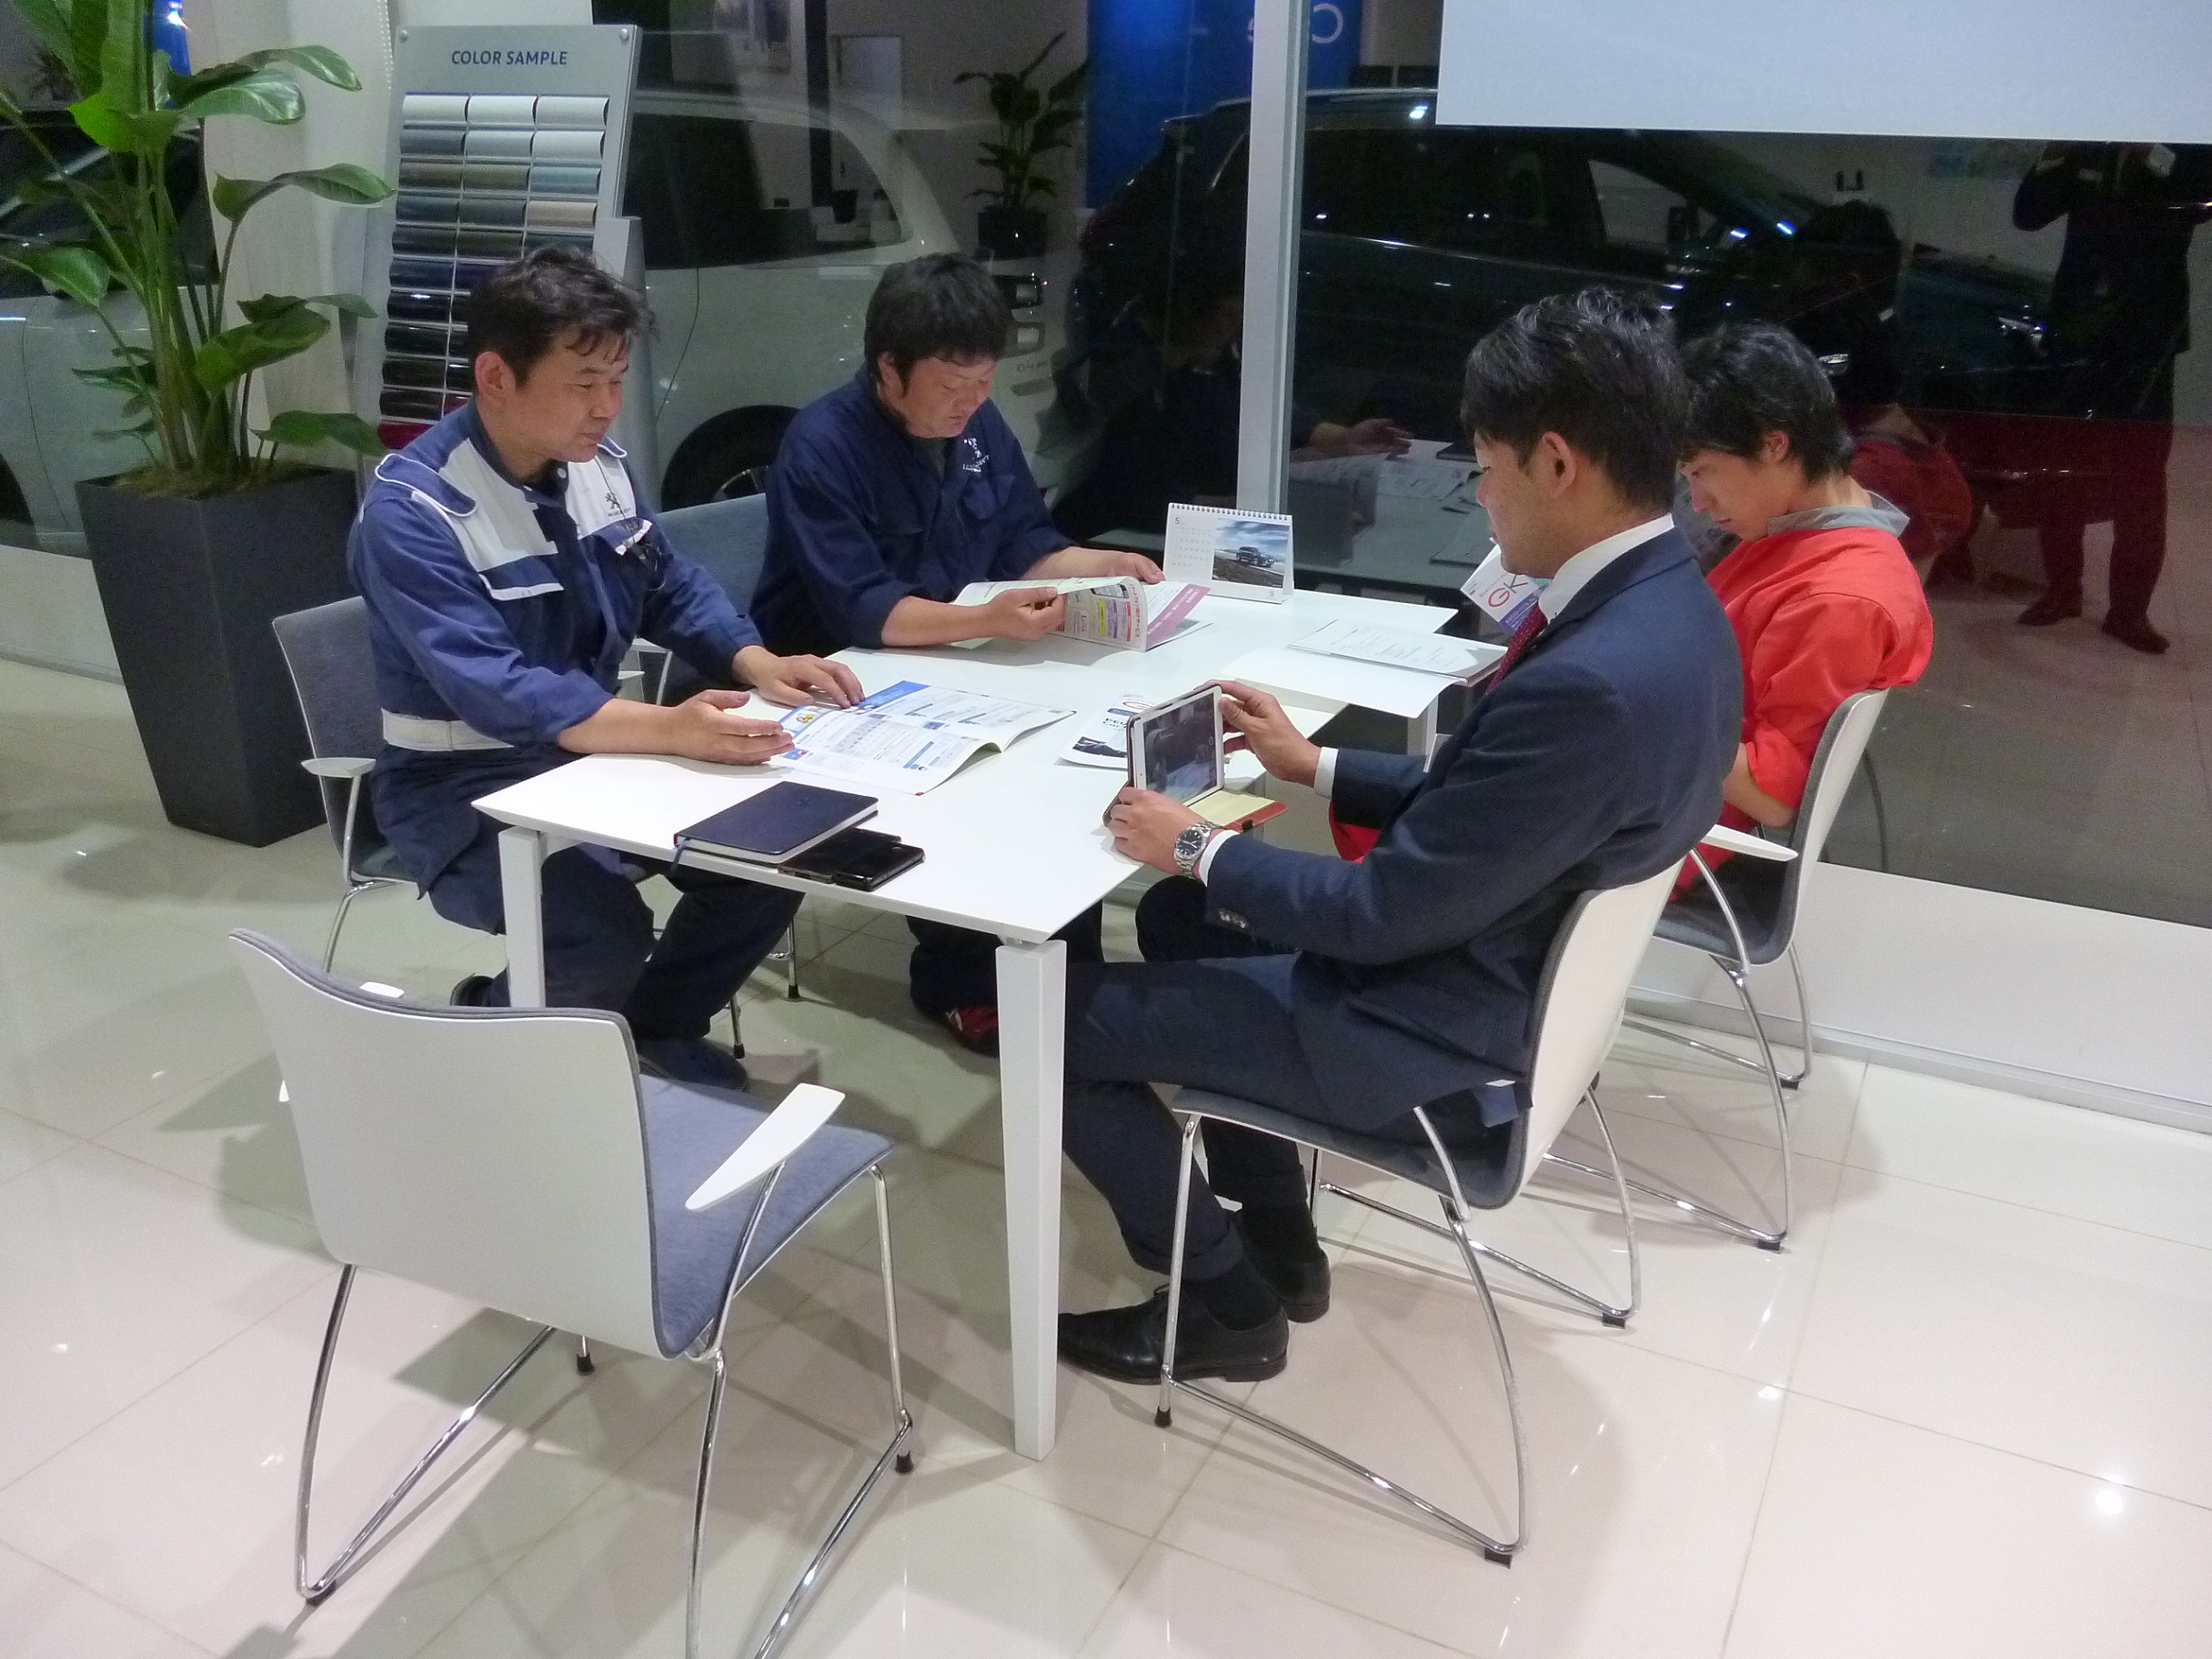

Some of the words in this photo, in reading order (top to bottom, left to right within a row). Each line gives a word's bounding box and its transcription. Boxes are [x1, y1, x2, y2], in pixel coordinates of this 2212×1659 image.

[451, 50, 501, 65] COLOR
[506, 51, 568, 65] SAMPLE
[1174, 517, 1181, 525] 5
